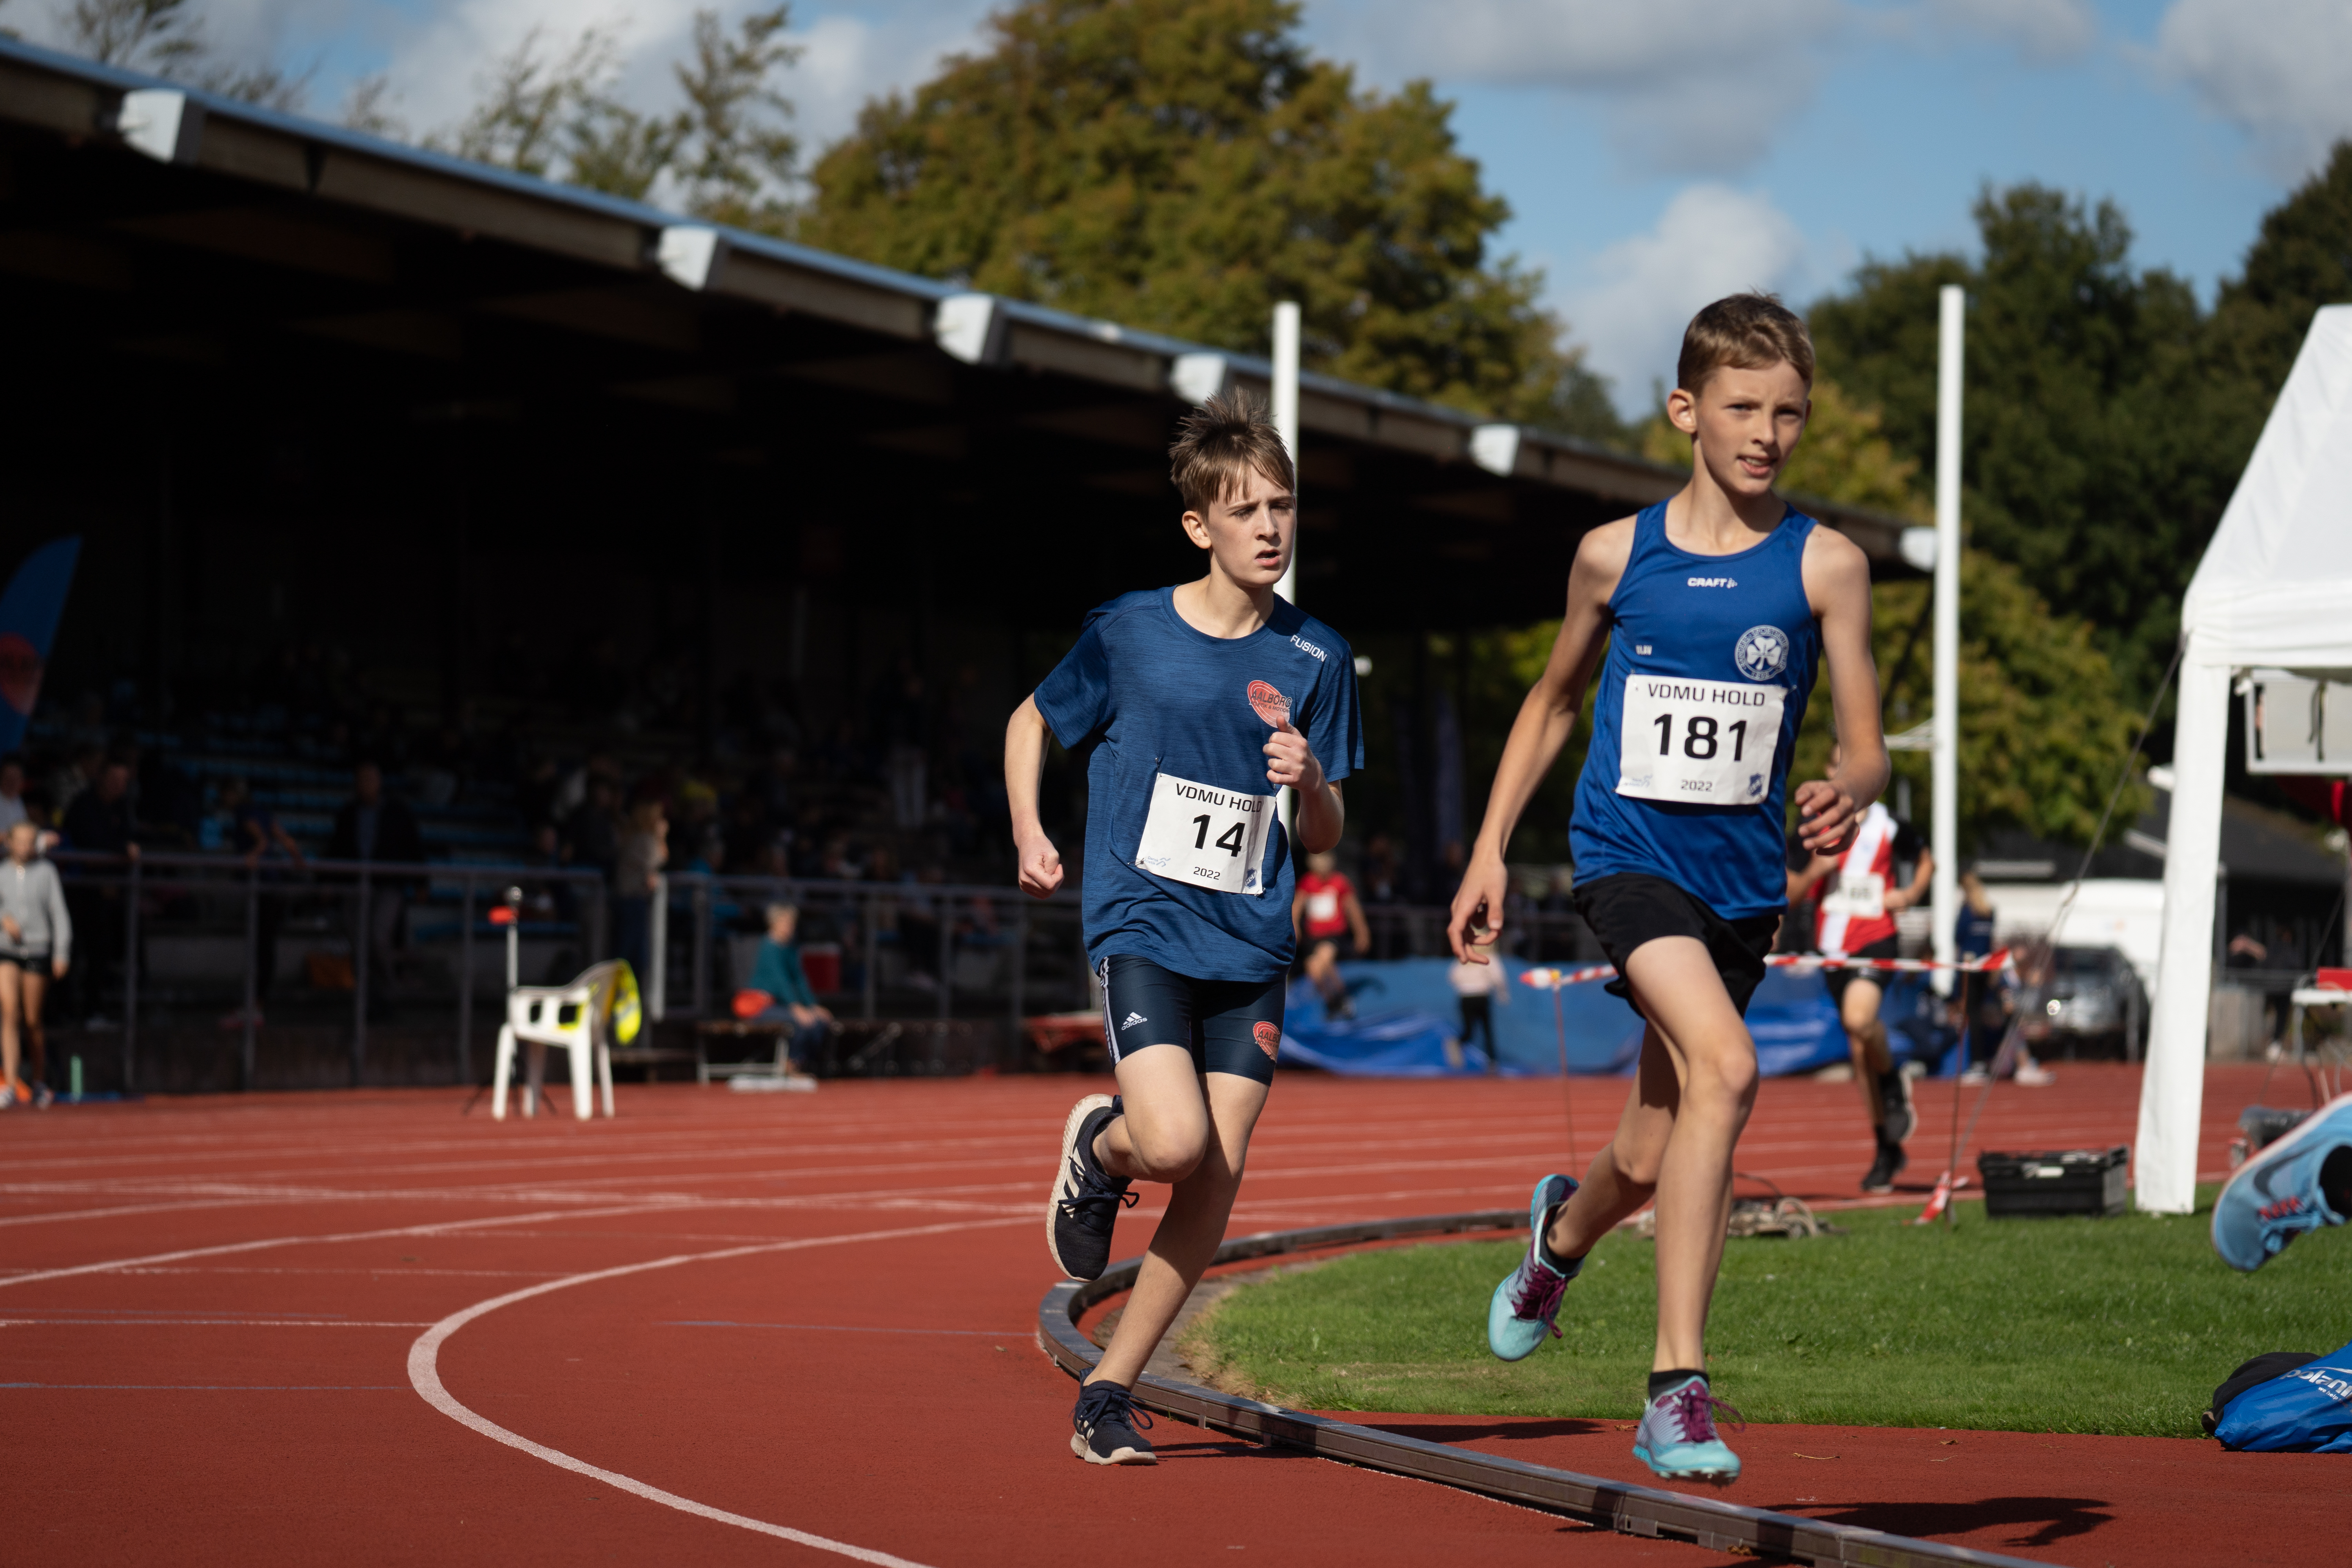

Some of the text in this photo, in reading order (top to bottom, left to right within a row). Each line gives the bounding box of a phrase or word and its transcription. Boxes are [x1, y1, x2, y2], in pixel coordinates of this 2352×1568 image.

[1688, 577, 1727, 587] CRAFT
[1290, 635, 1327, 662] FUSION
[1251, 690, 1292, 708] AALBORG
[1648, 684, 1765, 706] VDMU HOLD
[1654, 714, 1747, 762] 181
[1681, 779, 1713, 792] 2022
[1176, 783, 1262, 813] VDMU HOLD
[1193, 814, 1245, 857] 14
[1193, 867, 1221, 880] 2022
[1246, 871, 1256, 884] HCF
[1122, 1017, 1147, 1030] adidas
[2326, 1390, 2339, 1400] help
